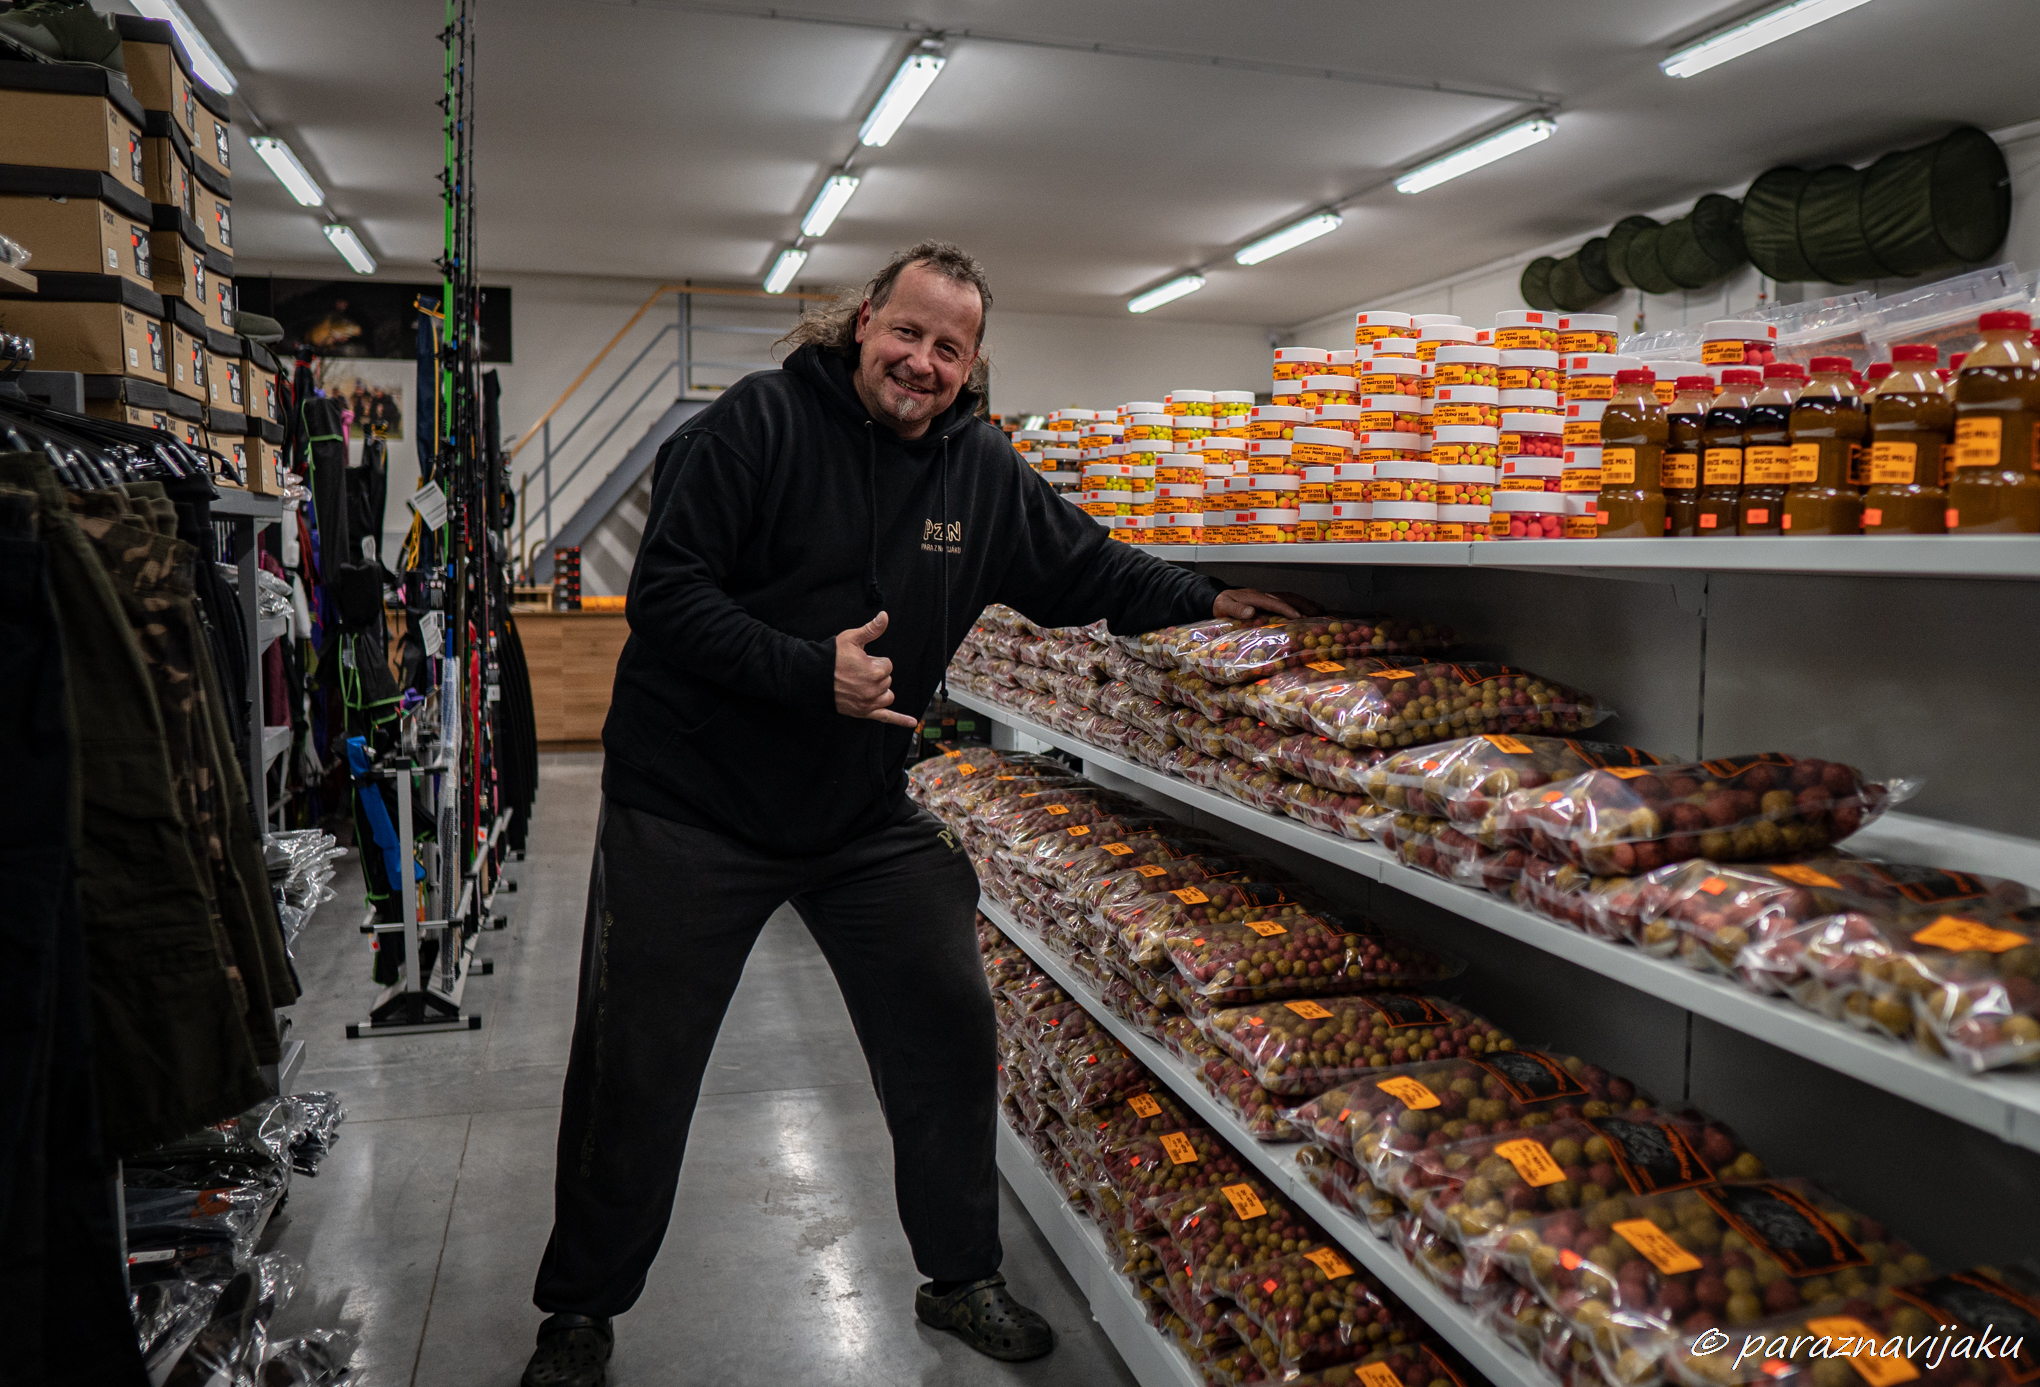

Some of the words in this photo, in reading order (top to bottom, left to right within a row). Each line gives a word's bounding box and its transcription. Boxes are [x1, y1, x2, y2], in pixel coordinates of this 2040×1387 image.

[103, 210, 114, 226] FOX
[124, 310, 135, 326] FOX
[130, 409, 140, 421] FOX
[168, 418, 176, 431] FOX
